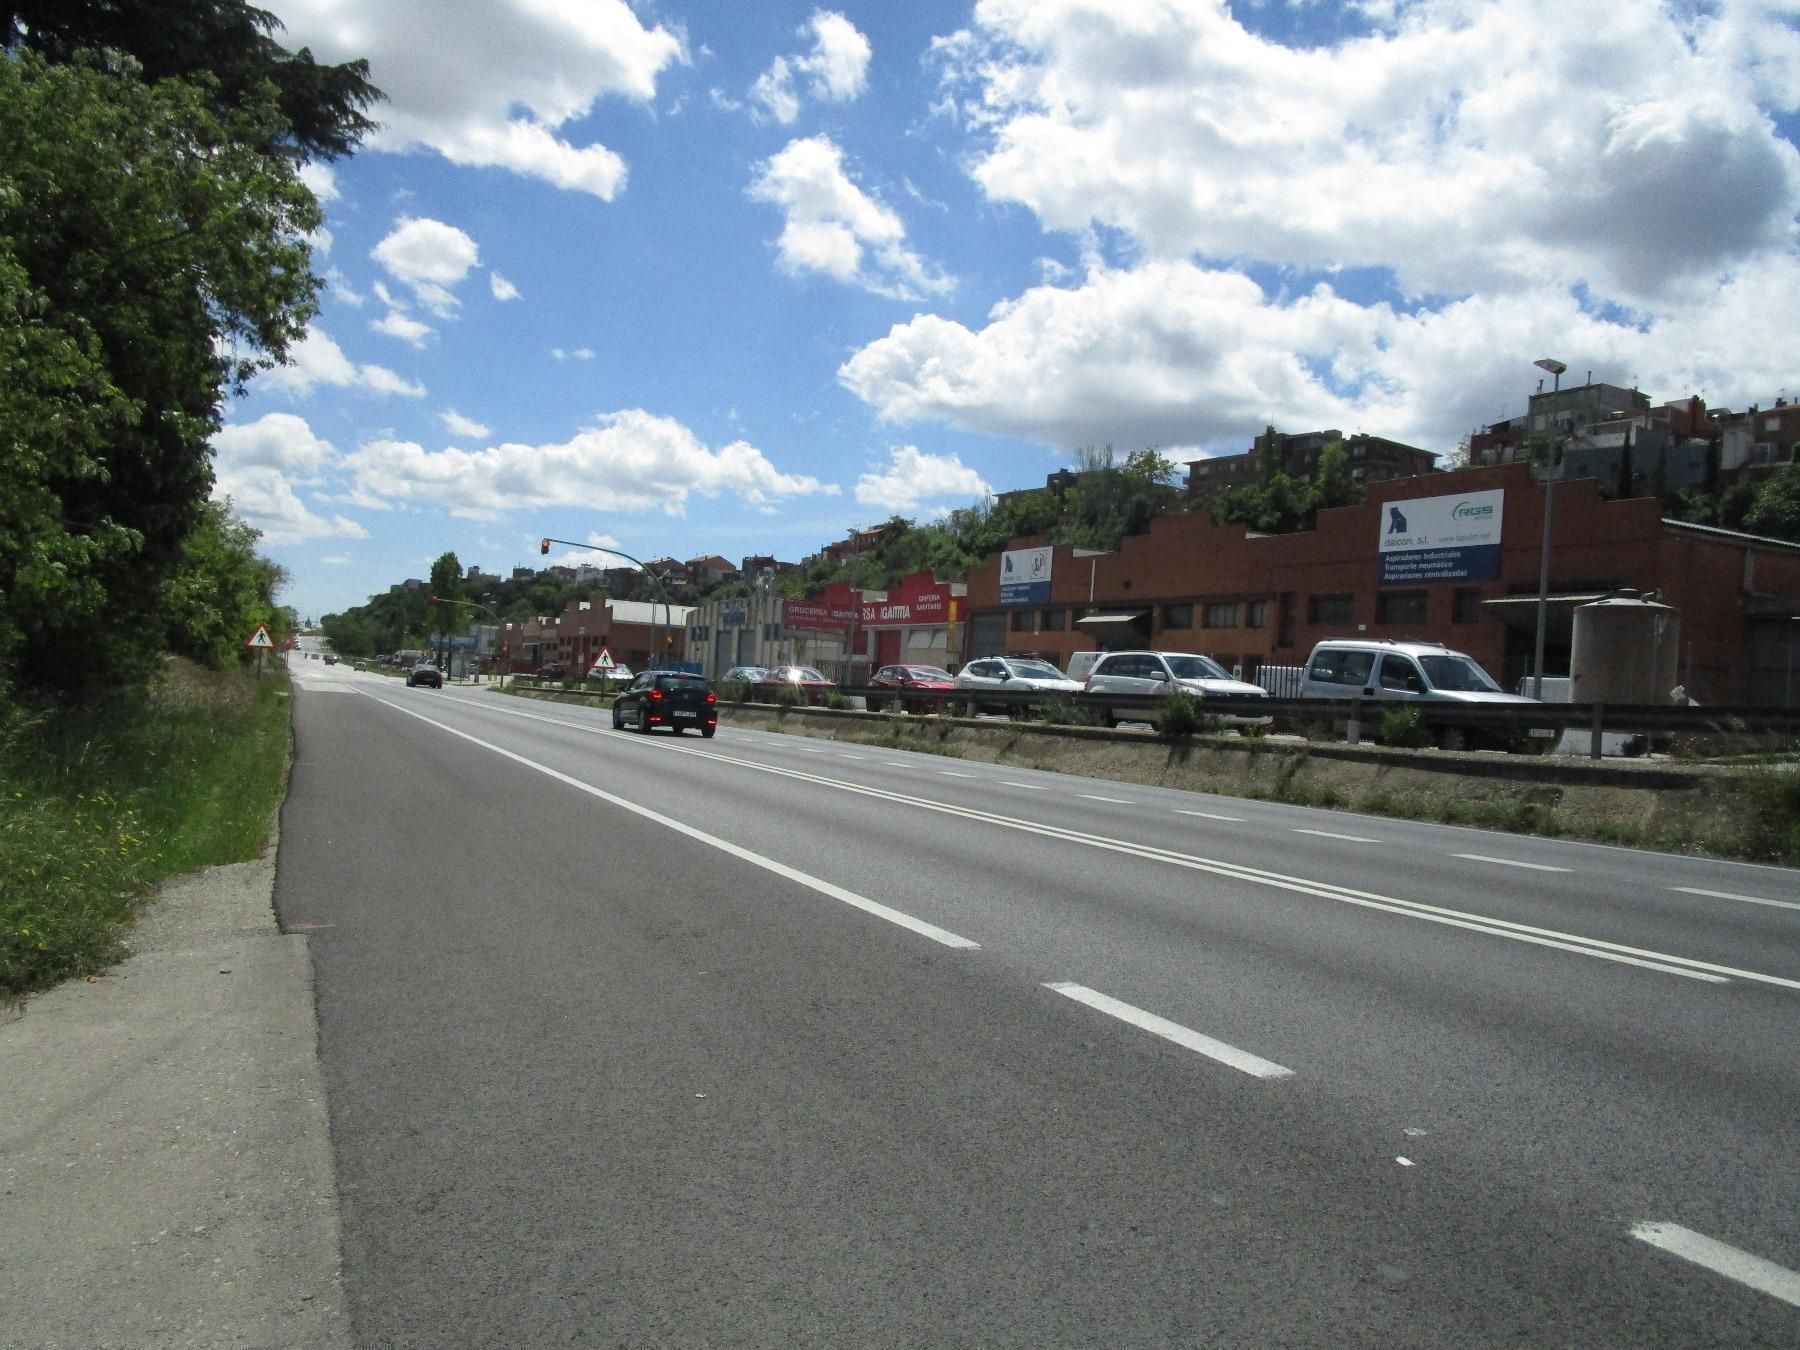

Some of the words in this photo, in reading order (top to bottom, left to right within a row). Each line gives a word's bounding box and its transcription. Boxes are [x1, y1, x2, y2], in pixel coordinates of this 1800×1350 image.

[1459, 505, 1493, 517] RGS
[1385, 553, 1422, 563] Aspiradores
[1384, 563, 1417, 572] Transporte
[1383, 572, 1422, 581] Aspiraciones
[1424, 570, 1468, 578] centralizadas
[788, 606, 828, 616] GRUCERSA
